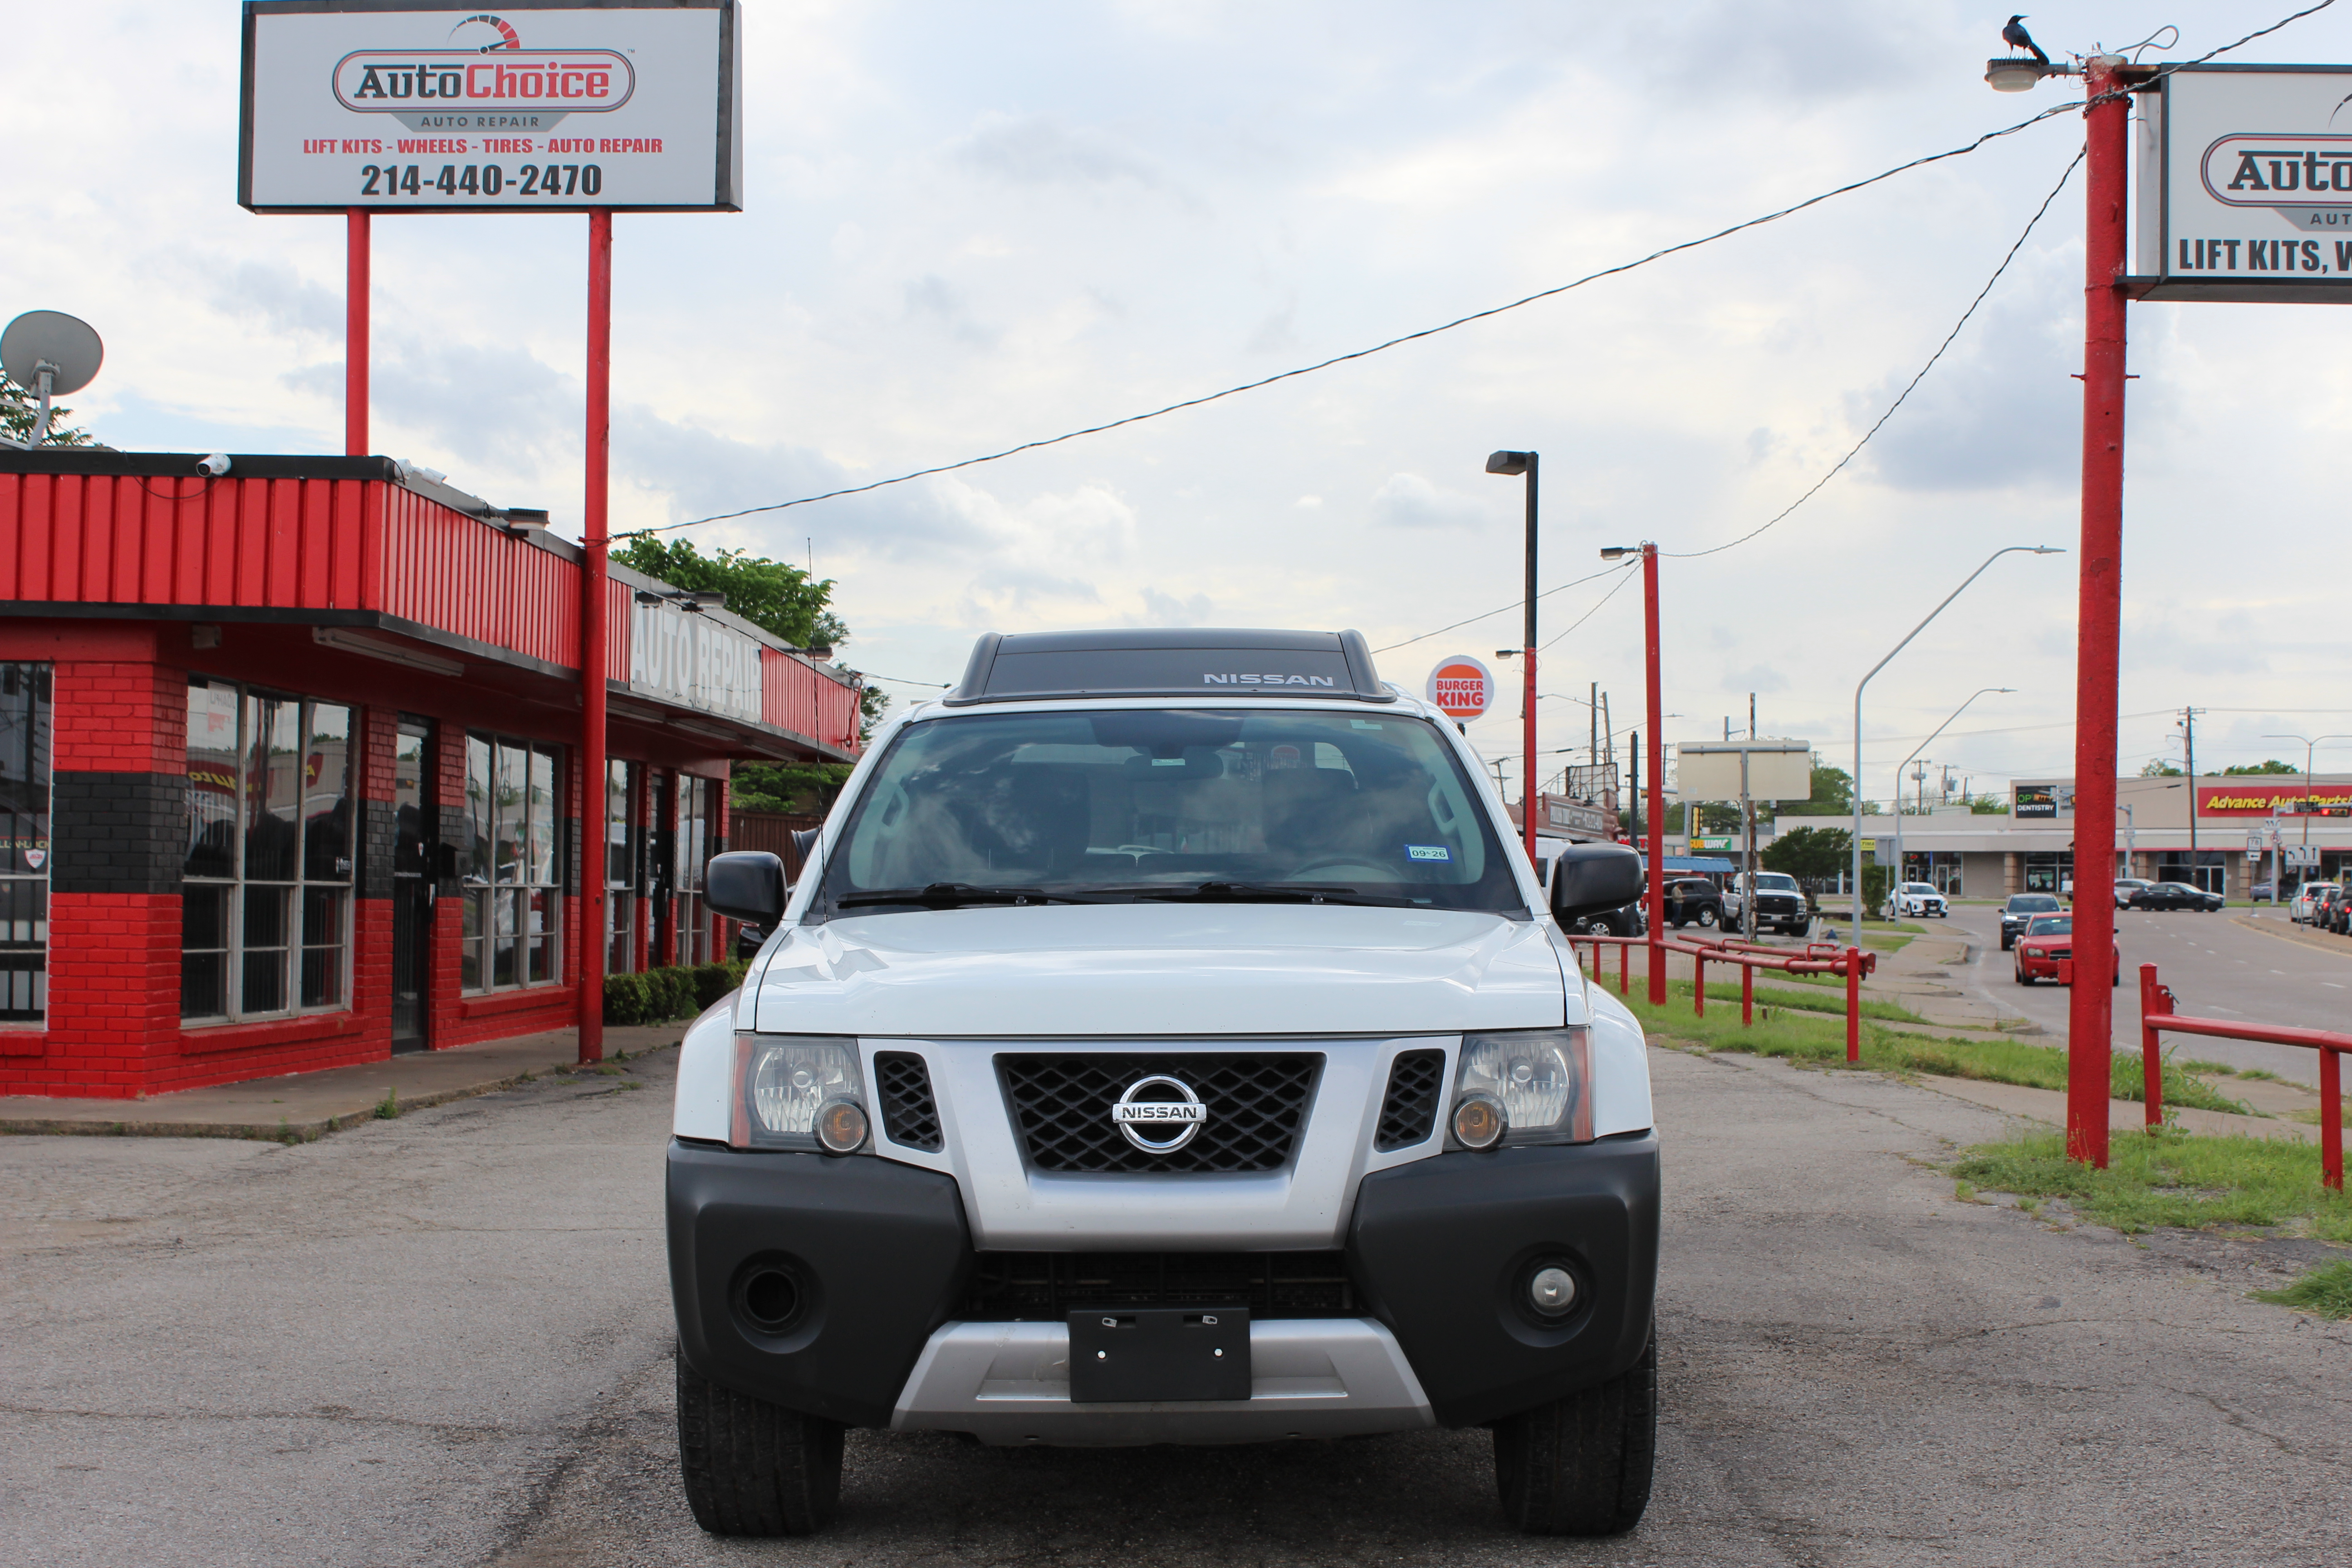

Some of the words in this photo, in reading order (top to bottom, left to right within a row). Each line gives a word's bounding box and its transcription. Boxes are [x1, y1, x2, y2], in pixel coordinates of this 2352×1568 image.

[354, 61, 612, 99] AutoChoice
[421, 116, 468, 127] AUTO
[477, 116, 539, 127] REPAIR
[304, 139, 338, 154] LIFT
[342, 139, 382, 154] KITS
[397, 139, 467, 153] WHEELS
[482, 138, 533, 153] TIRES
[548, 138, 595, 153] AUTO
[600, 138, 663, 153] REPAIR
[361, 164, 602, 196] 214-440-2470
[2310, 213, 2351, 225] AUT
[2180, 239, 2240, 270] LIFT
[2249, 240, 2328, 274] KITS,
[631, 601, 691, 697] AUTO
[698, 625, 761, 715] REPAIR
[1204, 674, 1333, 686] NISSAN
[1436, 681, 1484, 691] BURGER
[1437, 692, 1484, 706] KING
[2206, 795, 2266, 808] Advance
[1122, 1107, 1196, 1118] NISSAN
